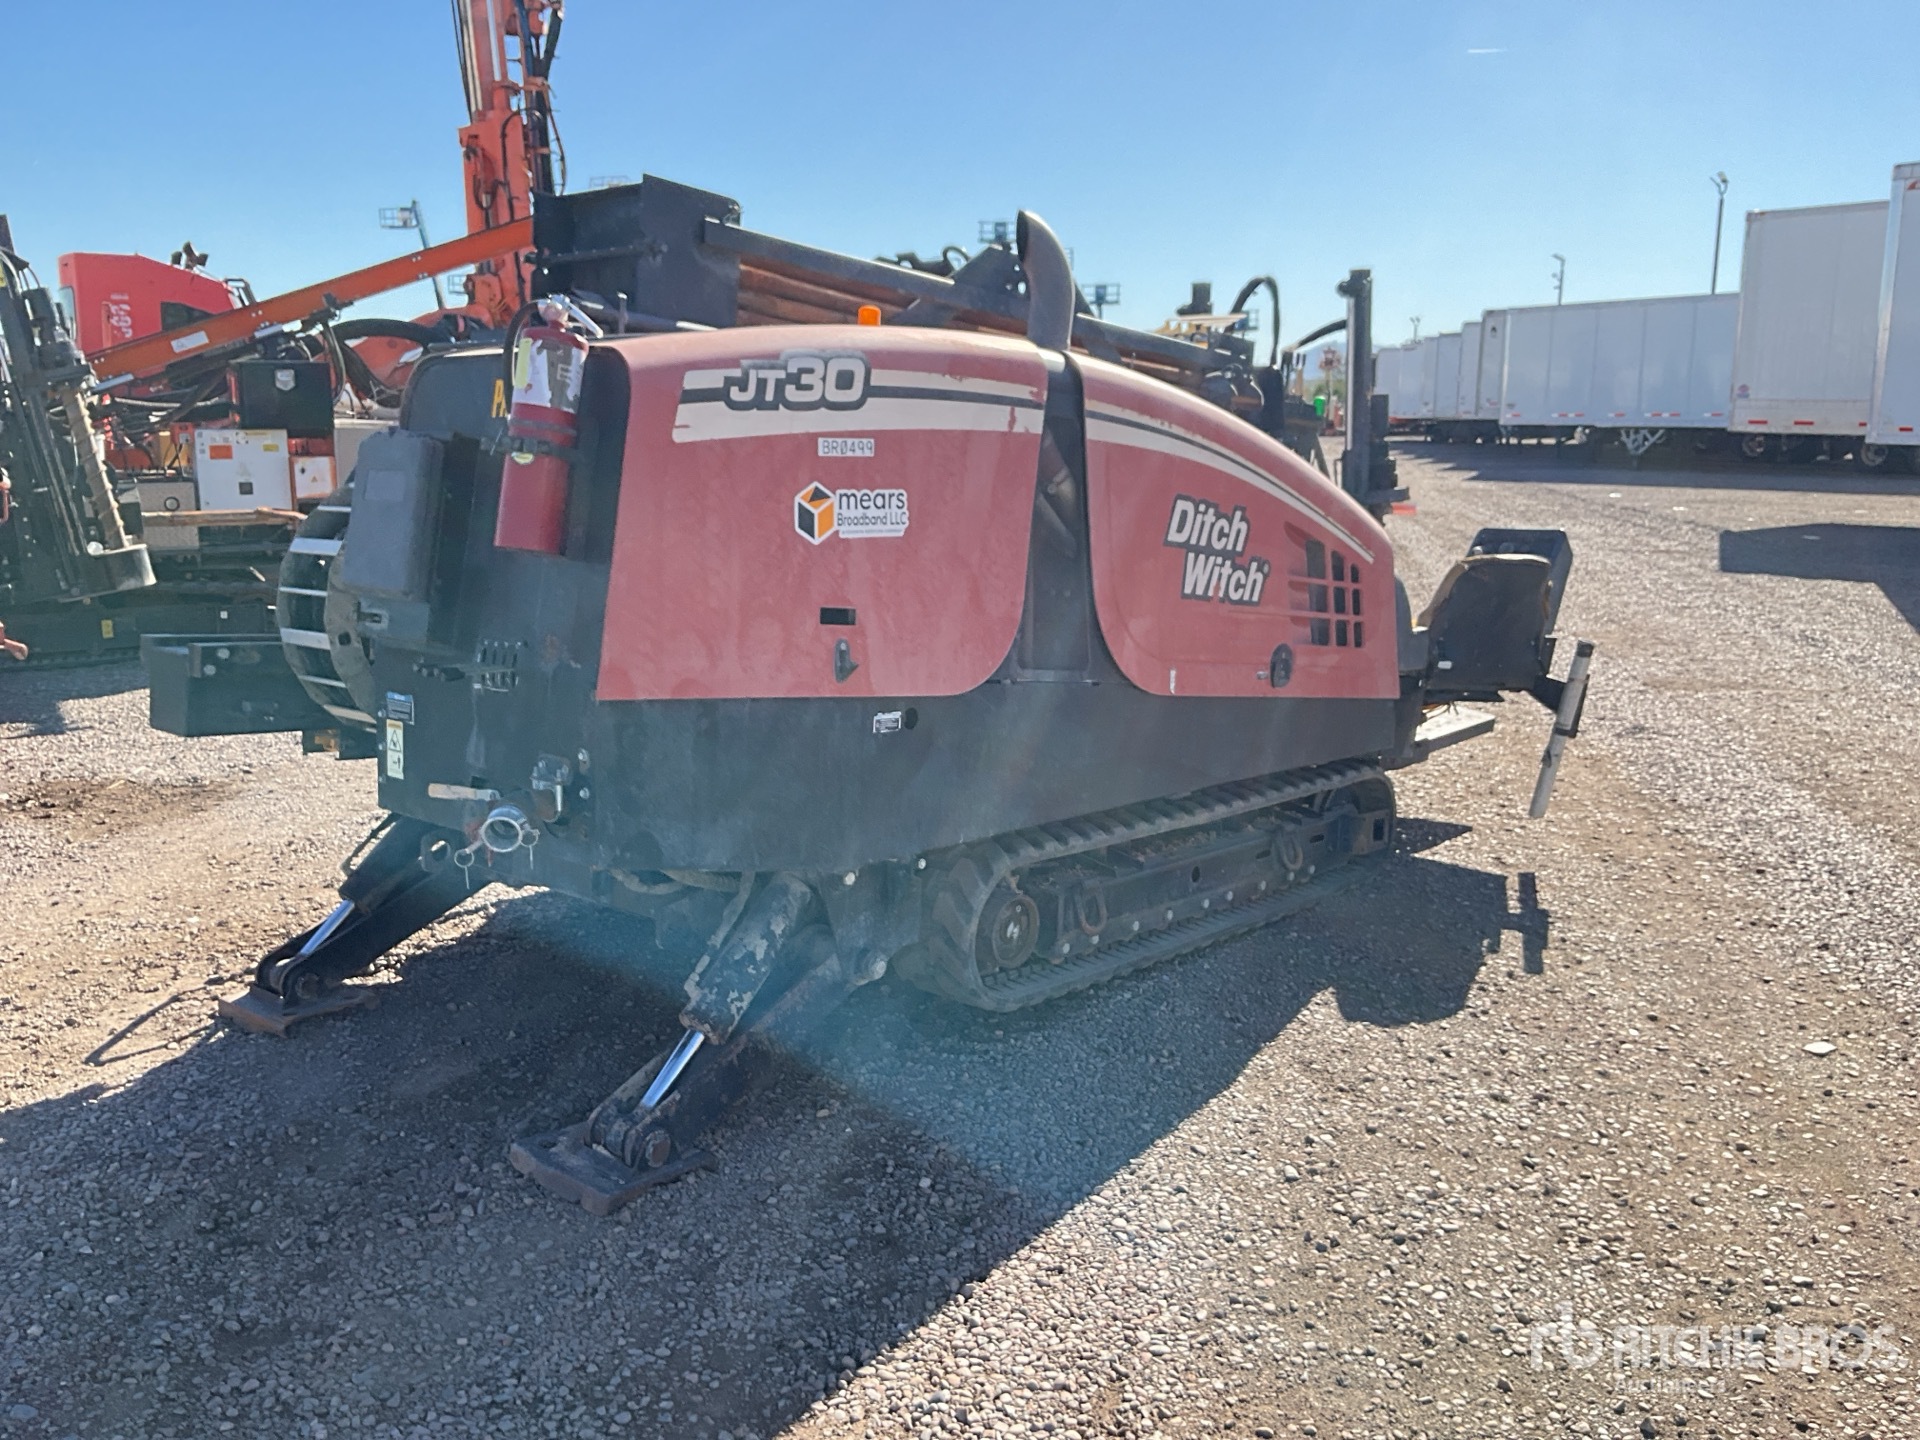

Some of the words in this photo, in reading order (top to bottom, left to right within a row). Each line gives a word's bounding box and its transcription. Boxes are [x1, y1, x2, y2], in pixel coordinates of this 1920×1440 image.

[728, 356, 866, 403] JT30
[837, 512, 888, 527] Broadband
[889, 511, 907, 526] LLC
[839, 492, 906, 510] mears
[1167, 499, 1248, 552] Ditch
[1183, 552, 1264, 602] Witch
